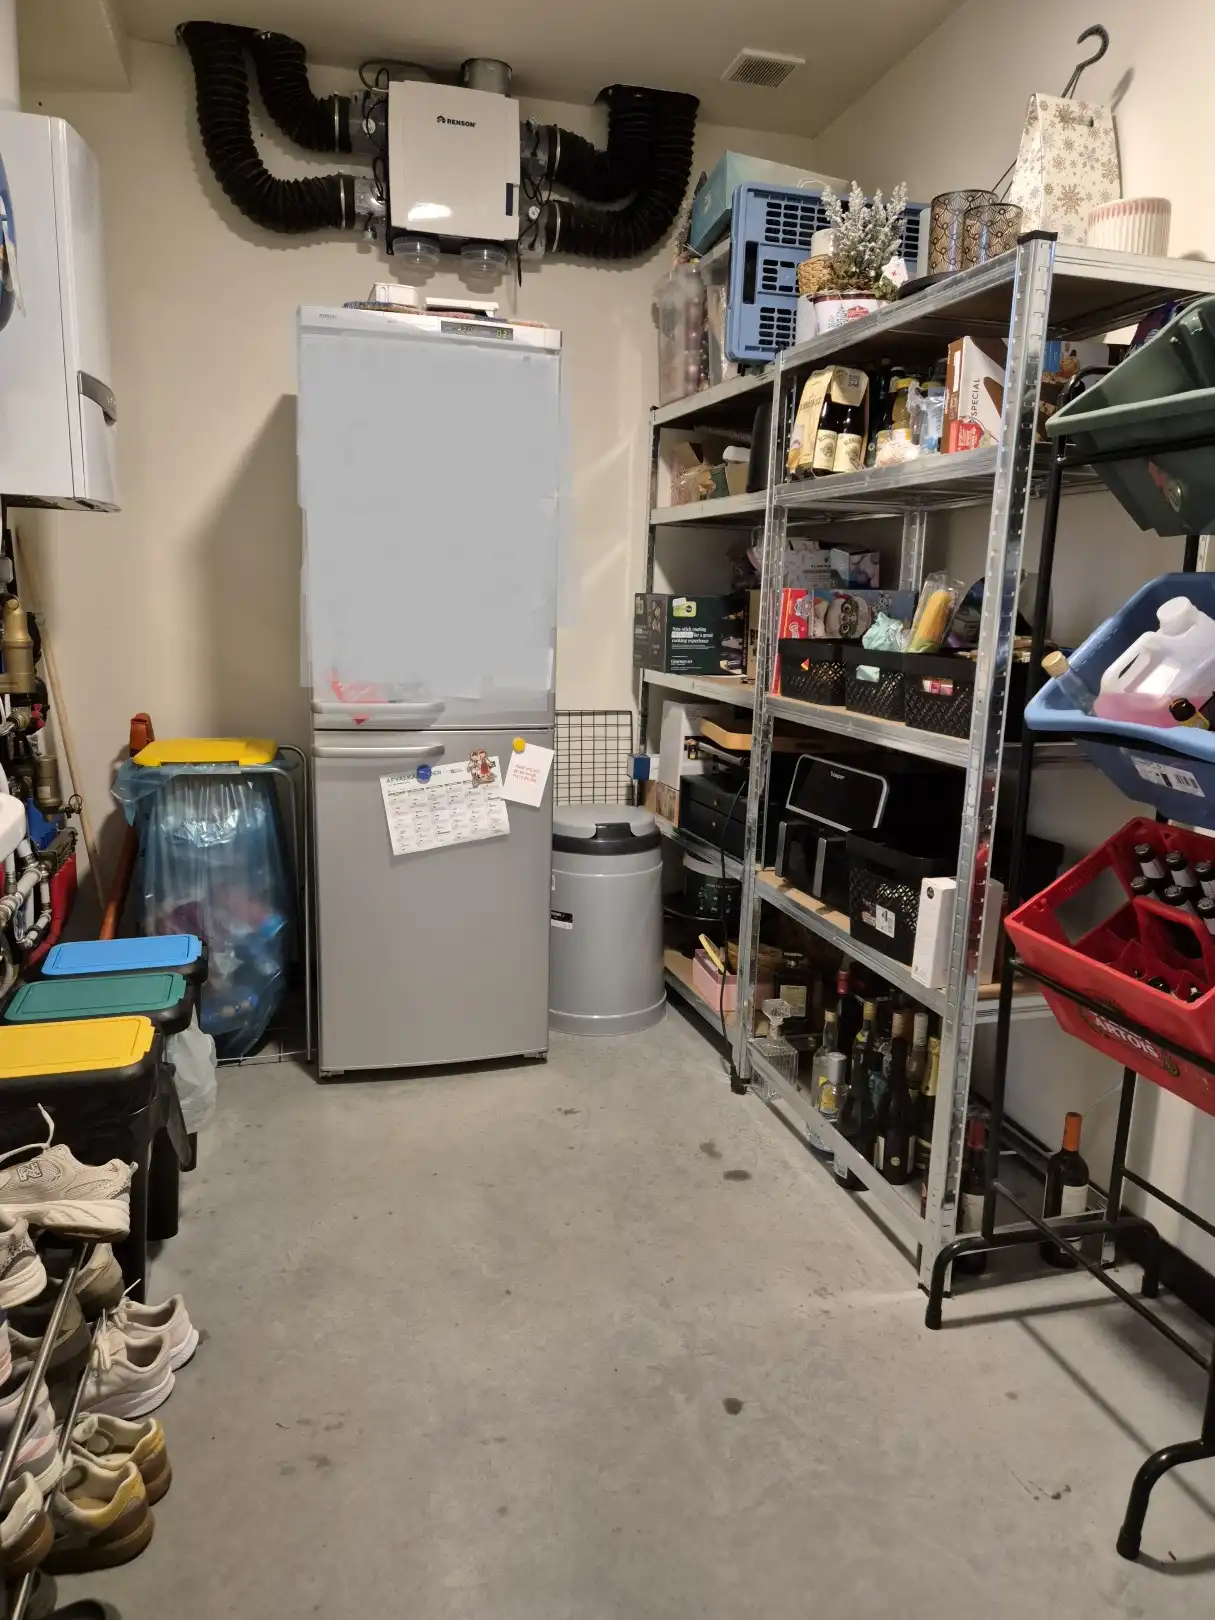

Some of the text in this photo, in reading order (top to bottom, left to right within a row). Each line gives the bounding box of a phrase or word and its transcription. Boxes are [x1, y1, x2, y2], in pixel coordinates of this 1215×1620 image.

[447, 119, 475, 128] RENSON
[971, 377, 980, 417] SPECIAL
[1095, 1015, 1160, 1059] ARTOIS
